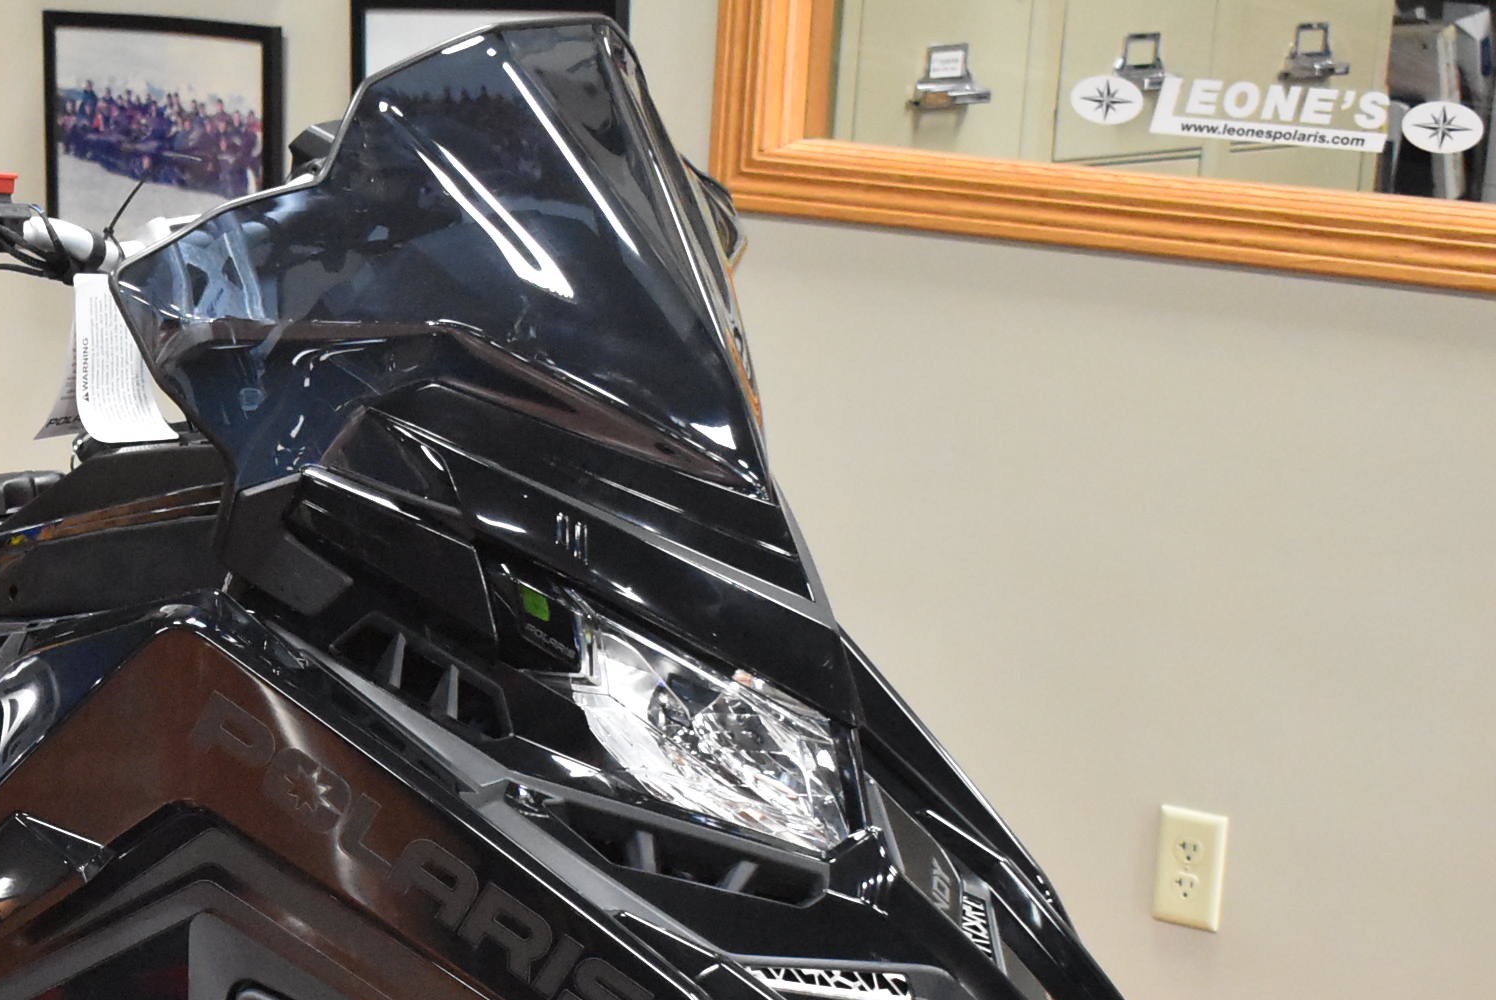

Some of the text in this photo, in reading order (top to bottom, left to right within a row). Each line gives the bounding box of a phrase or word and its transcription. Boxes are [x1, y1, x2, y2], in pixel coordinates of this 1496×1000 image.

[1151, 75, 1391, 134] LEONE'S
[1179, 120, 1366, 149] www.leonespolaris.com
[81, 336, 90, 393] WARNING
[930, 857, 951, 911] NDY
